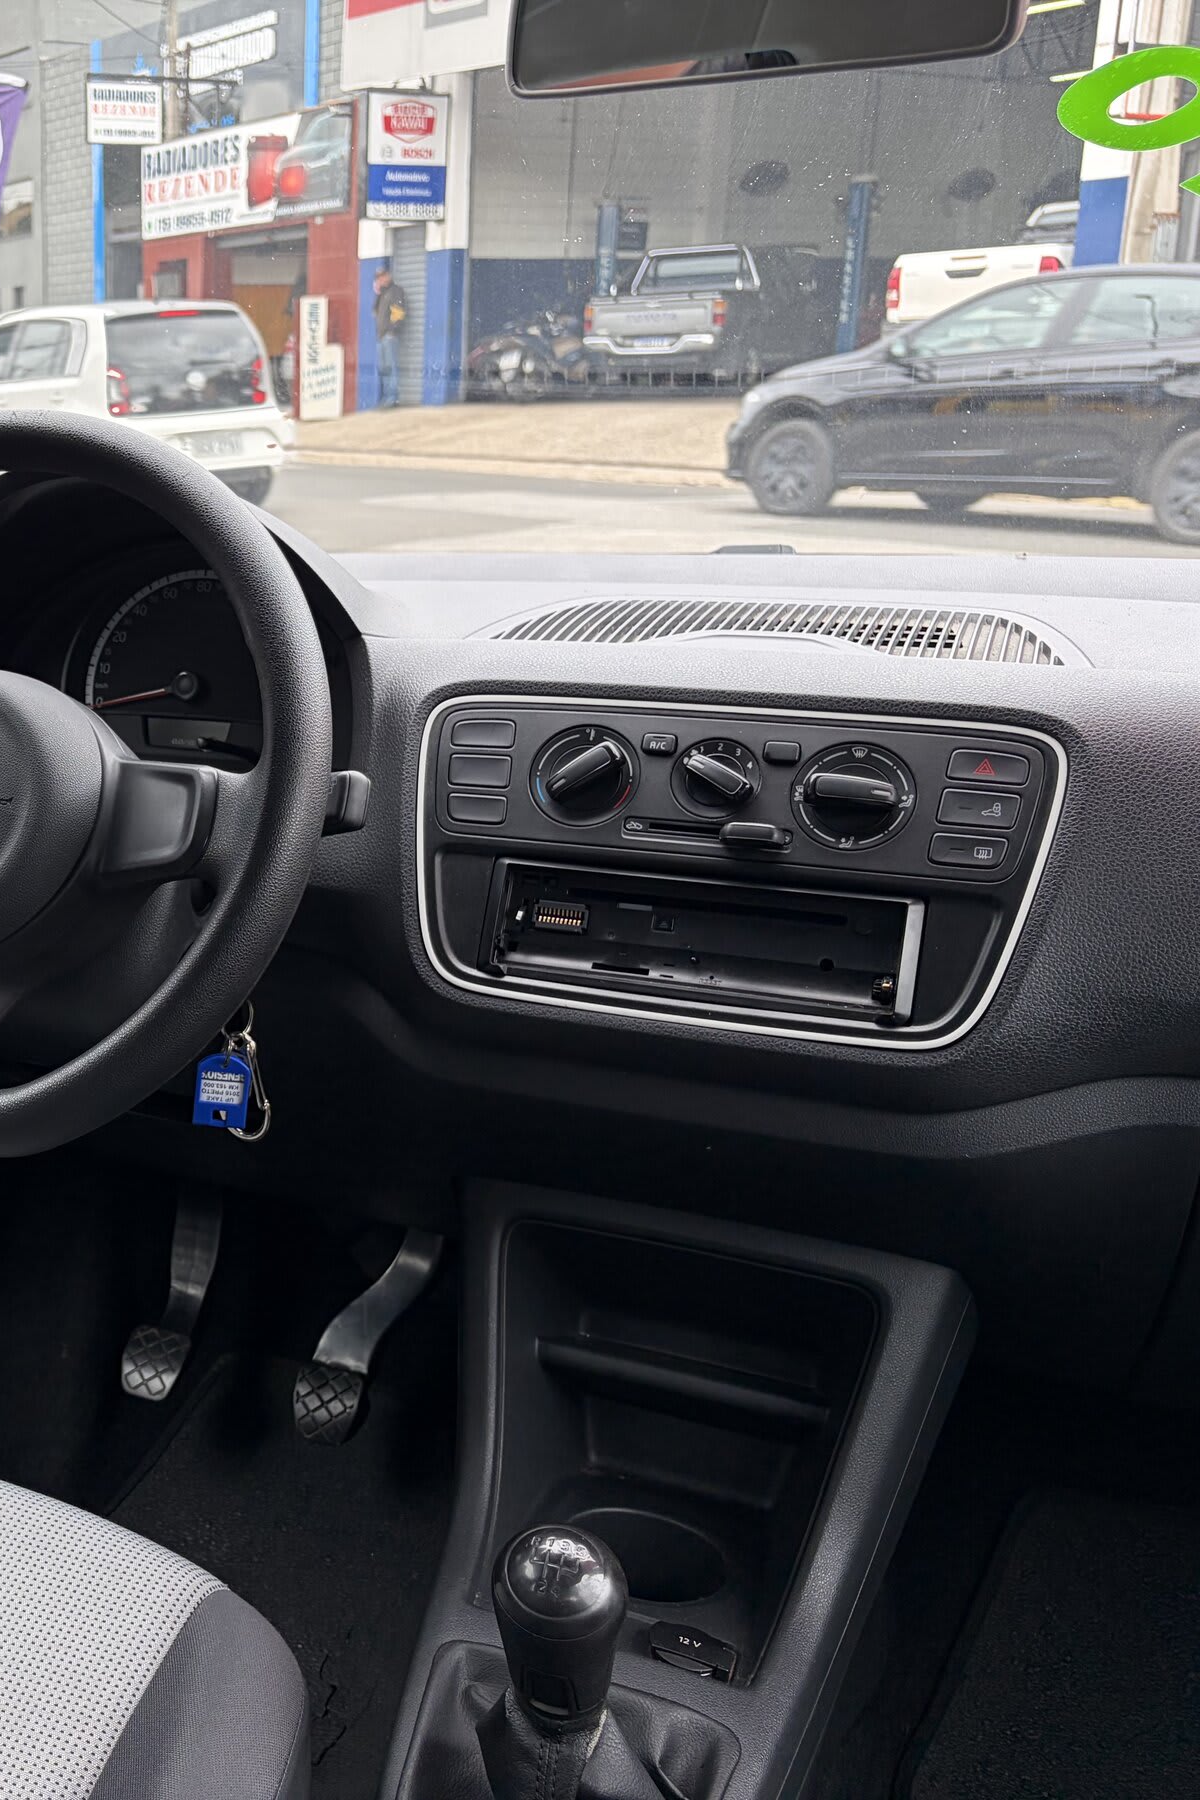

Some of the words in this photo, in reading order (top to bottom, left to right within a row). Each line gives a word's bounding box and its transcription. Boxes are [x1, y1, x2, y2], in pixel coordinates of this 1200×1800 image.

[144, 133, 240, 179] RADIADORES
[144, 167, 241, 205] REZENDE
[162, 588, 178, 600] 60
[133, 605, 148, 616] 40
[112, 631, 127, 643] 20
[100, 662, 110, 674] 10
[649, 741, 667, 750] A/C
[717, 743, 724, 751] 2
[735, 748, 742, 756] 3
[746, 761, 753, 769] 4
[201, 1088, 224, 1096] PRETO
[678, 1636, 690, 1646] 12
[693, 1640, 702, 1648] V
